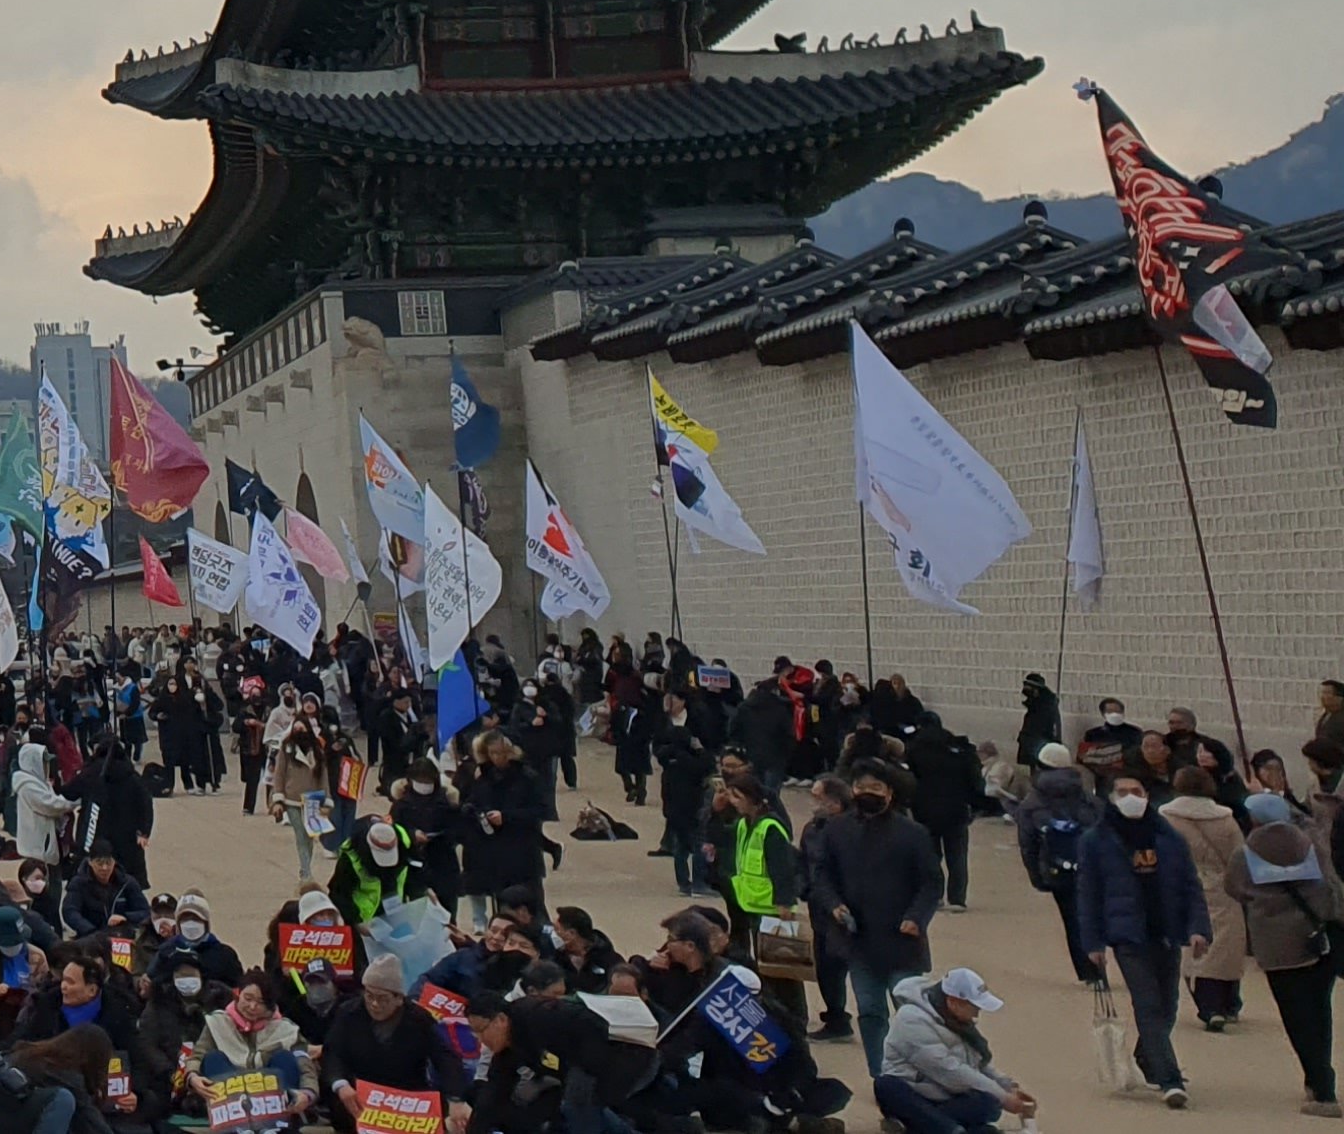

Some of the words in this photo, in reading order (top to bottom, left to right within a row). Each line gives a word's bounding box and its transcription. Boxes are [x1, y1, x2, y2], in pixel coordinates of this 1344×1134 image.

[289, 929, 345, 946] 윤석열을
[366, 1090, 431, 1114] 윤석열을
[358, 1108, 441, 1133] 파면하라!
